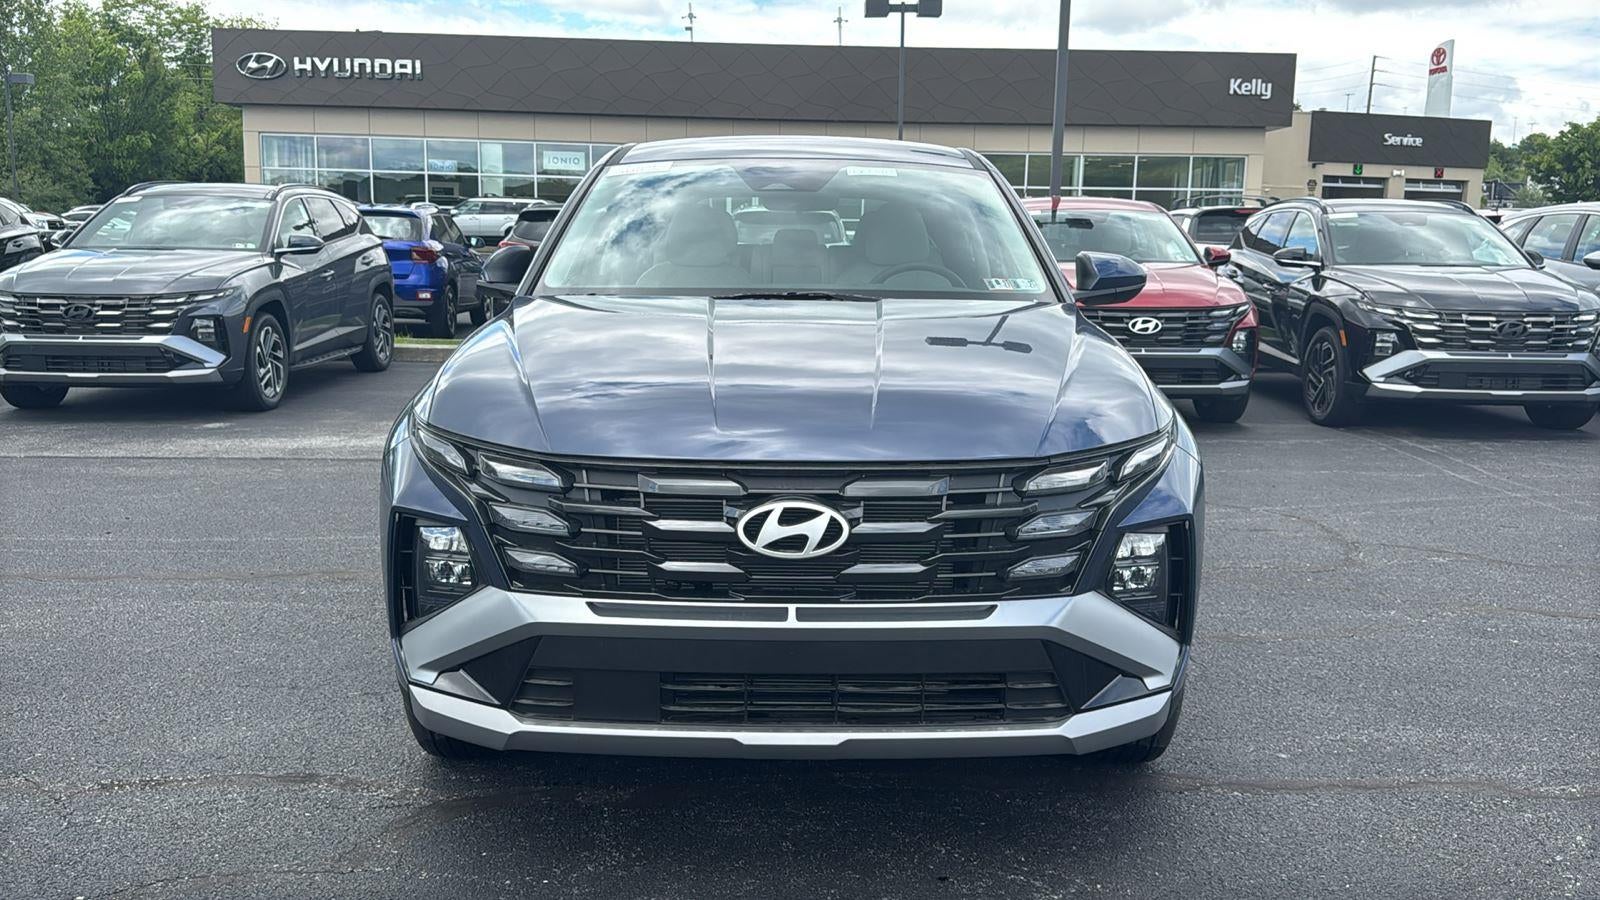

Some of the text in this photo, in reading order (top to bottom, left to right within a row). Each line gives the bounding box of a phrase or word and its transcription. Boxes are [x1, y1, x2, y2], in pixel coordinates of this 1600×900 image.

[293, 56, 422, 80] HYUNDAI
[1229, 78, 1272, 100] Kelly
[1383, 133, 1423, 147] Service
